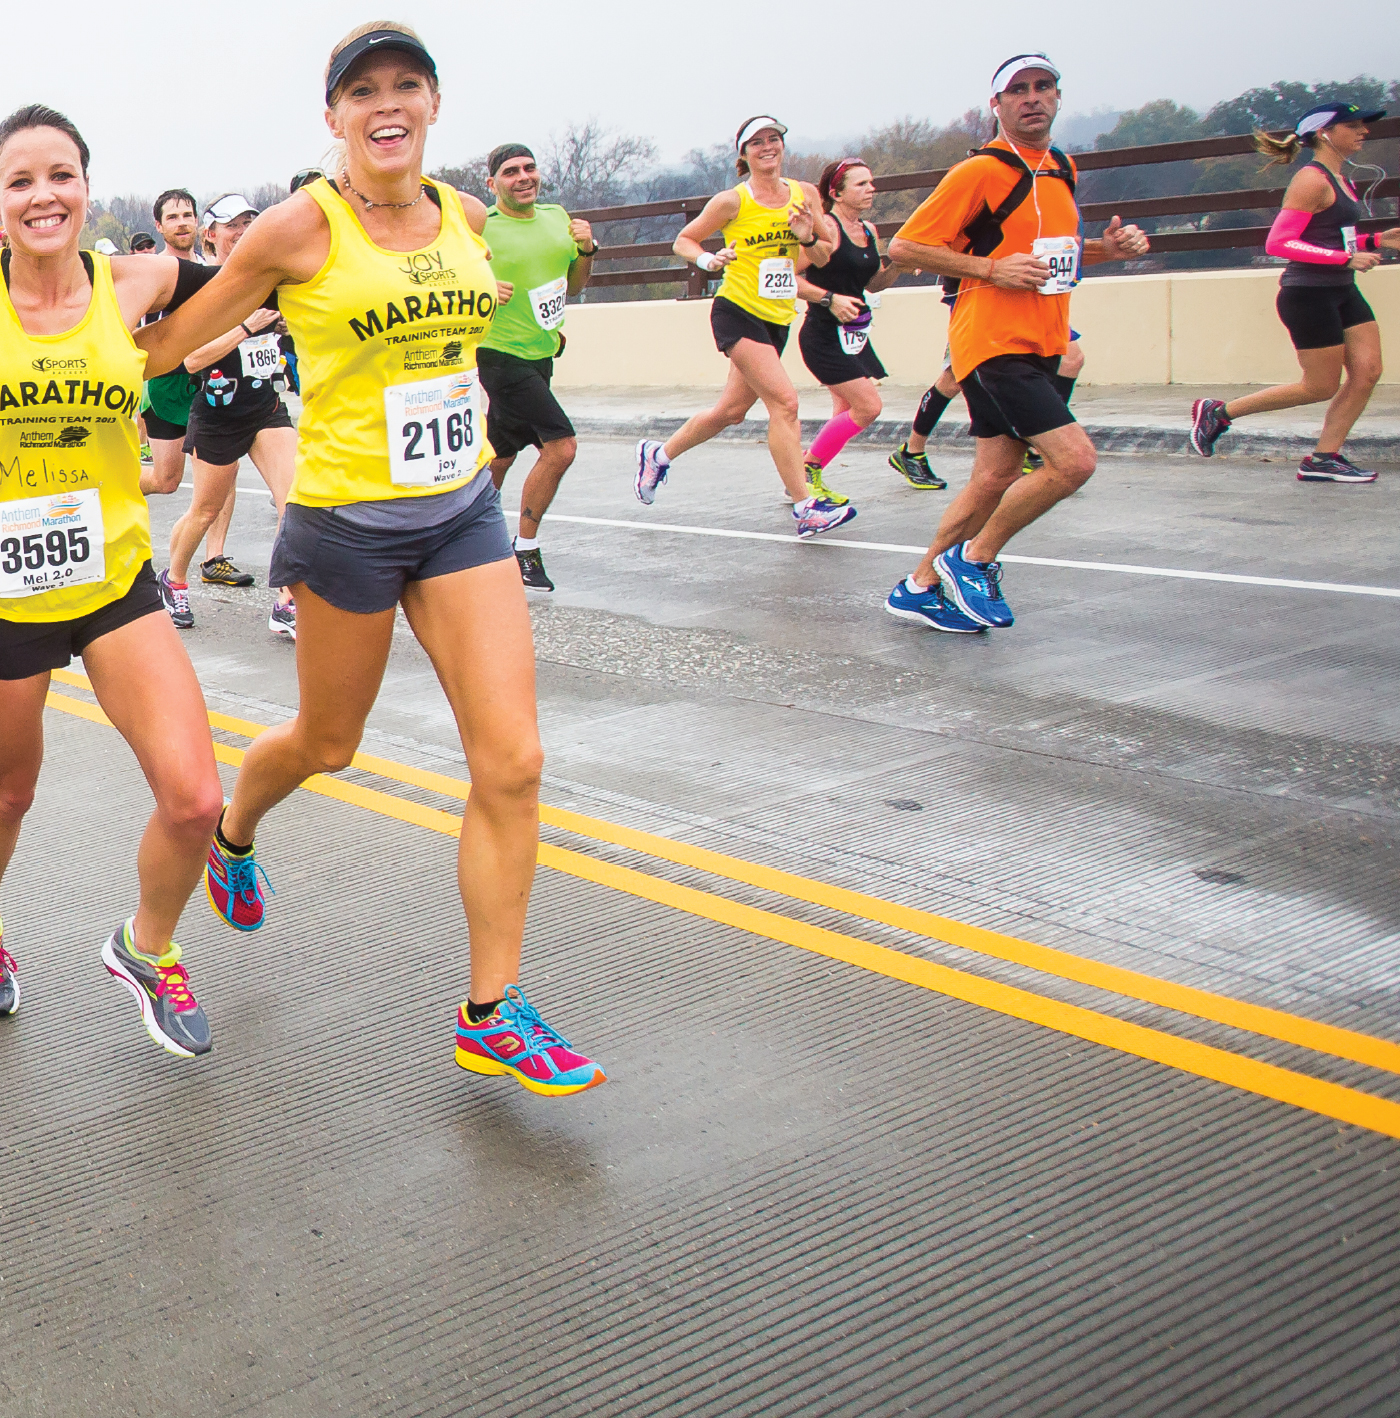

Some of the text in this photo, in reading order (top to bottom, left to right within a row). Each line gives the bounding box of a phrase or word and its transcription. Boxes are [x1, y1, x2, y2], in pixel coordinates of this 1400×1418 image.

[1284, 240, 1333, 256] saucony
[398, 251, 443, 273] JOY
[420, 269, 456, 281] SPORTS
[385, 330, 438, 345] TRAINING
[439, 326, 467, 337] TEAM
[404, 349, 438, 362] Anthem
[46, 358, 87, 369] SPORTS
[404, 360, 438, 370] Richmond
[404, 388, 443, 405] Anthem
[404, 401, 443, 416] Richmond
[0, 416, 117, 426] TRAINING TEAM 2013
[20, 431, 54, 441] Anthem
[402, 408, 473, 461] 2168
[438, 459, 457, 472] joy
[433, 473, 455, 482] Wave
[1, 507, 41, 522] Anthem
[2, 514, 81, 533] Richmond Marathon
[0, 526, 90, 574] 3595
[23, 572, 48, 585] Mel
[52, 568, 73, 581] 2.0
[32, 584, 56, 592] Wave
